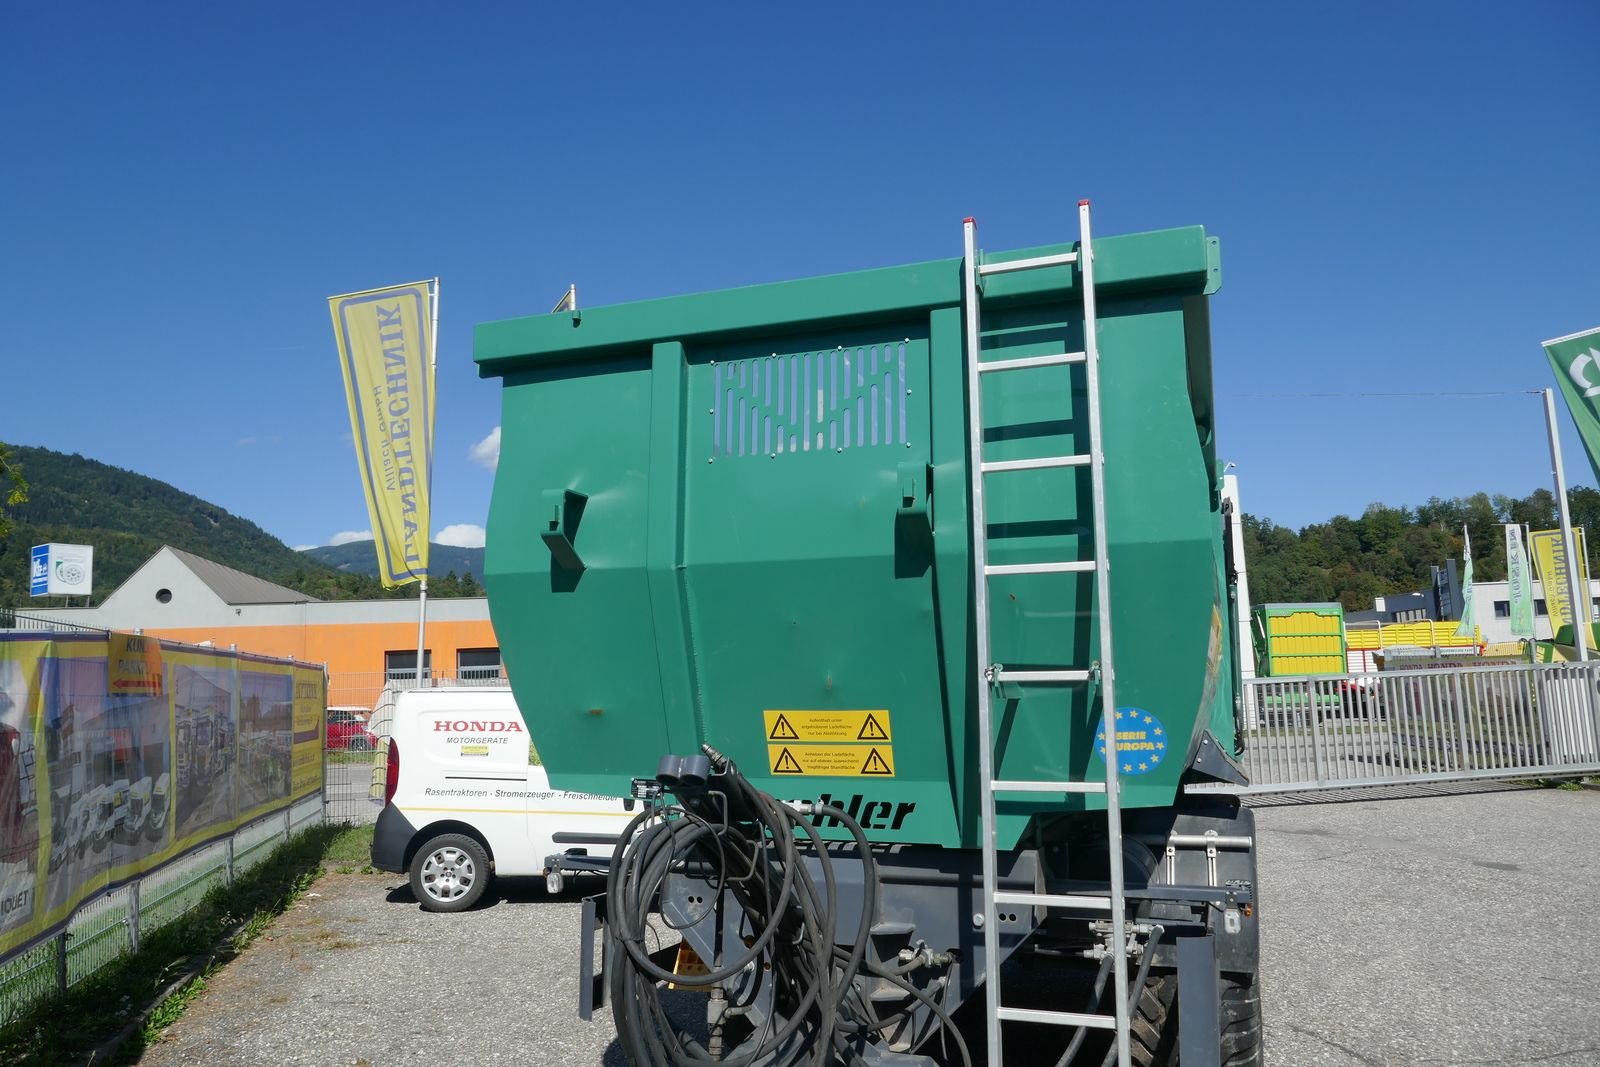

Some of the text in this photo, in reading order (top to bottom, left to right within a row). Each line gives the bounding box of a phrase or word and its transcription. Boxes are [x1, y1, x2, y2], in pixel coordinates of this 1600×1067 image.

[433, 720, 523, 732] HONDA
[446, 735, 509, 744] MOTORGERÄTE
[1115, 742, 1155, 751] UROPA
[425, 787, 488, 797] Rasentraktoren
[495, 789, 555, 800] Stromerzeuger
